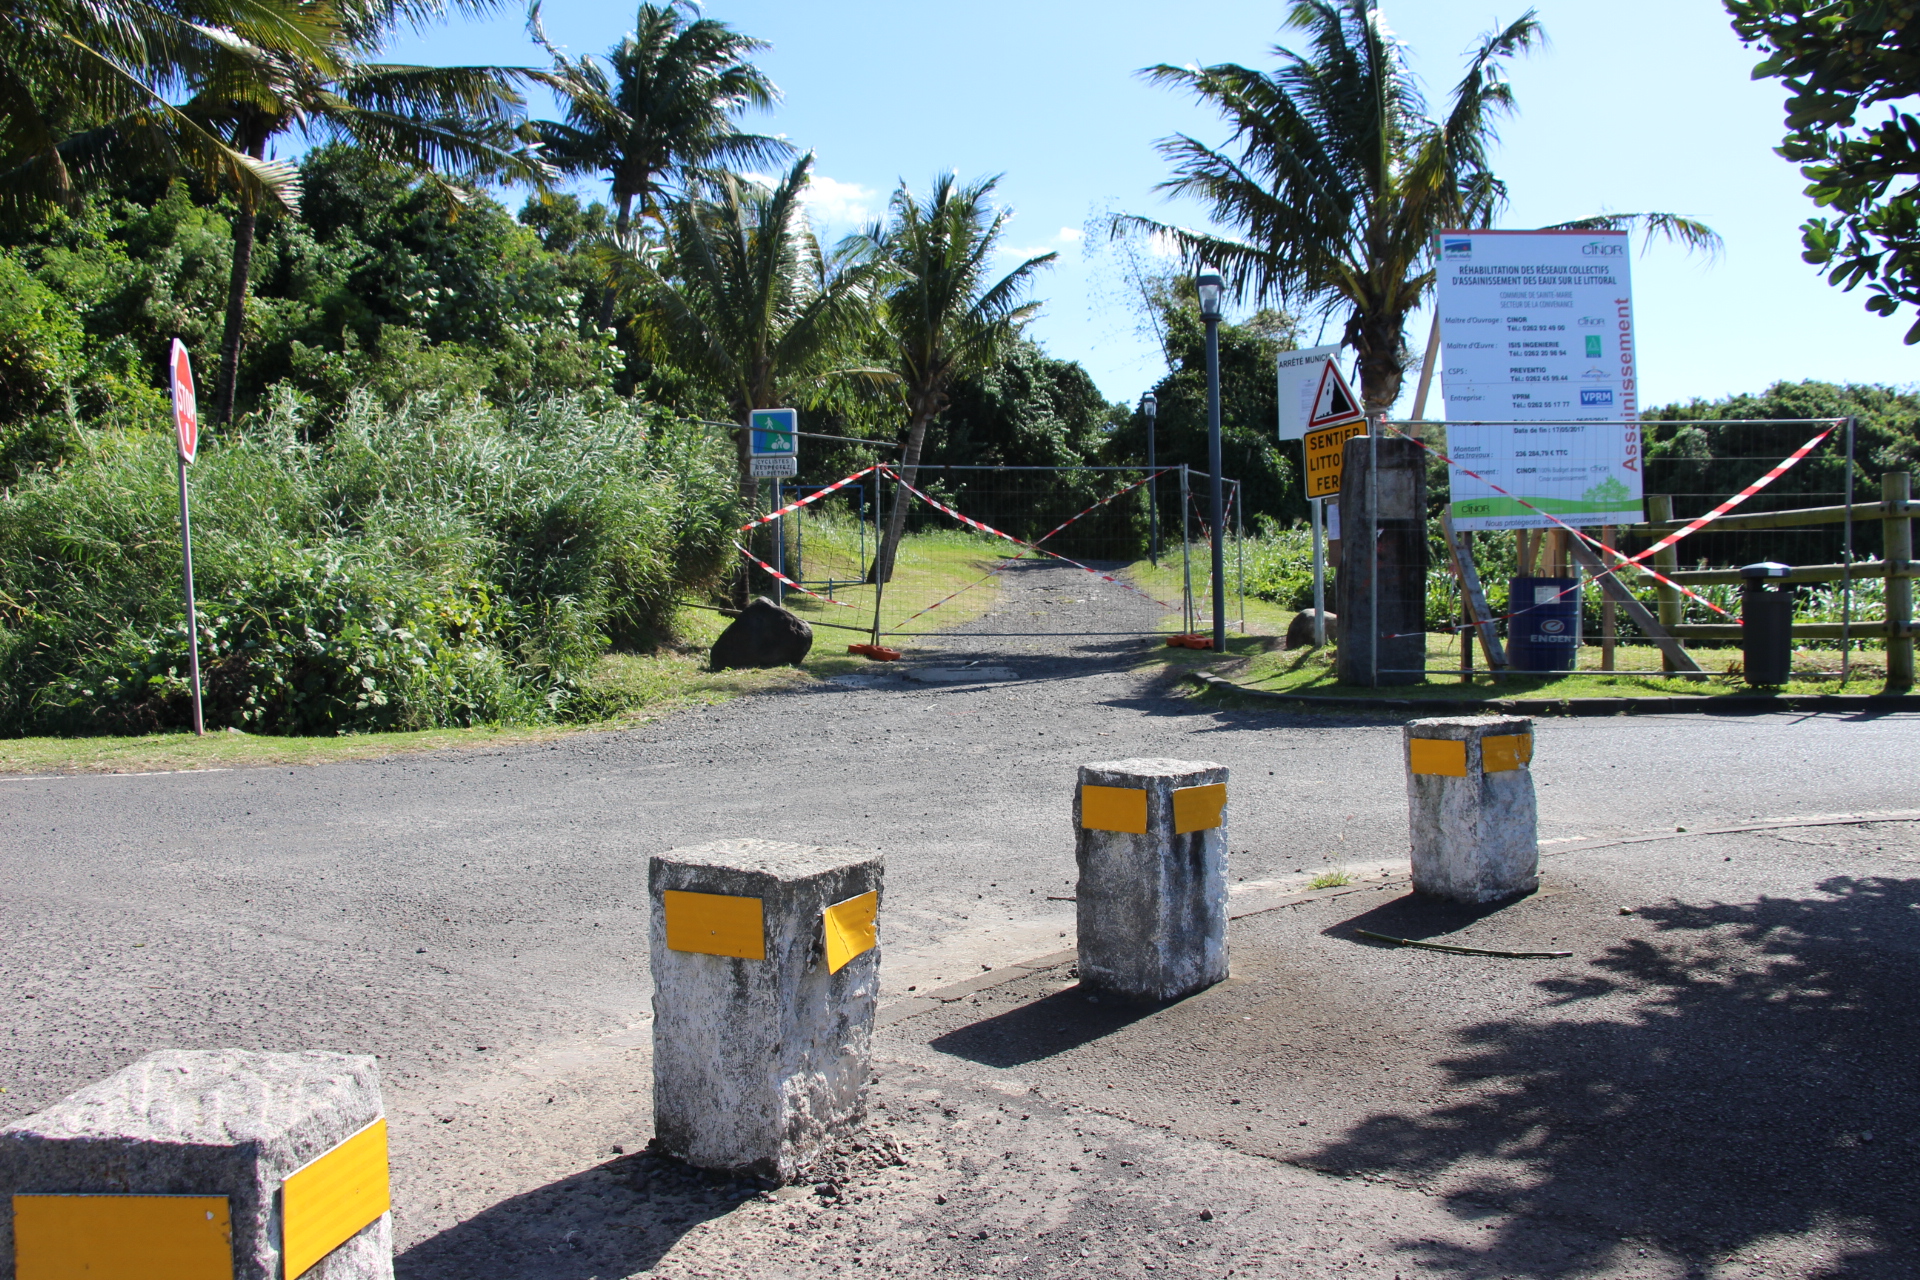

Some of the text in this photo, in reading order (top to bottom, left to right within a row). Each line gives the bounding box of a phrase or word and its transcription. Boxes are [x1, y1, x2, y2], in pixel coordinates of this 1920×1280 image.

[1582, 242, 1623, 256] CINOR
[1459, 264, 1610, 274] RÉHABILITATION DES RÉSEAUX COLLECTIFS
[1452, 276, 1617, 285] D'ASSAINISSEMENT DES EAUX SUR LE LITTORAL
[1279, 356, 1304, 368] ARRÊTÉ
[1614, 298, 1638, 472] Assainissement
[178, 380, 195, 422] STOP
[1582, 392, 1611, 402] VPRM
[1310, 452, 1343, 471] LITTO
[1462, 504, 1490, 514] CINOR
[1530, 634, 1571, 642] ENGEN
